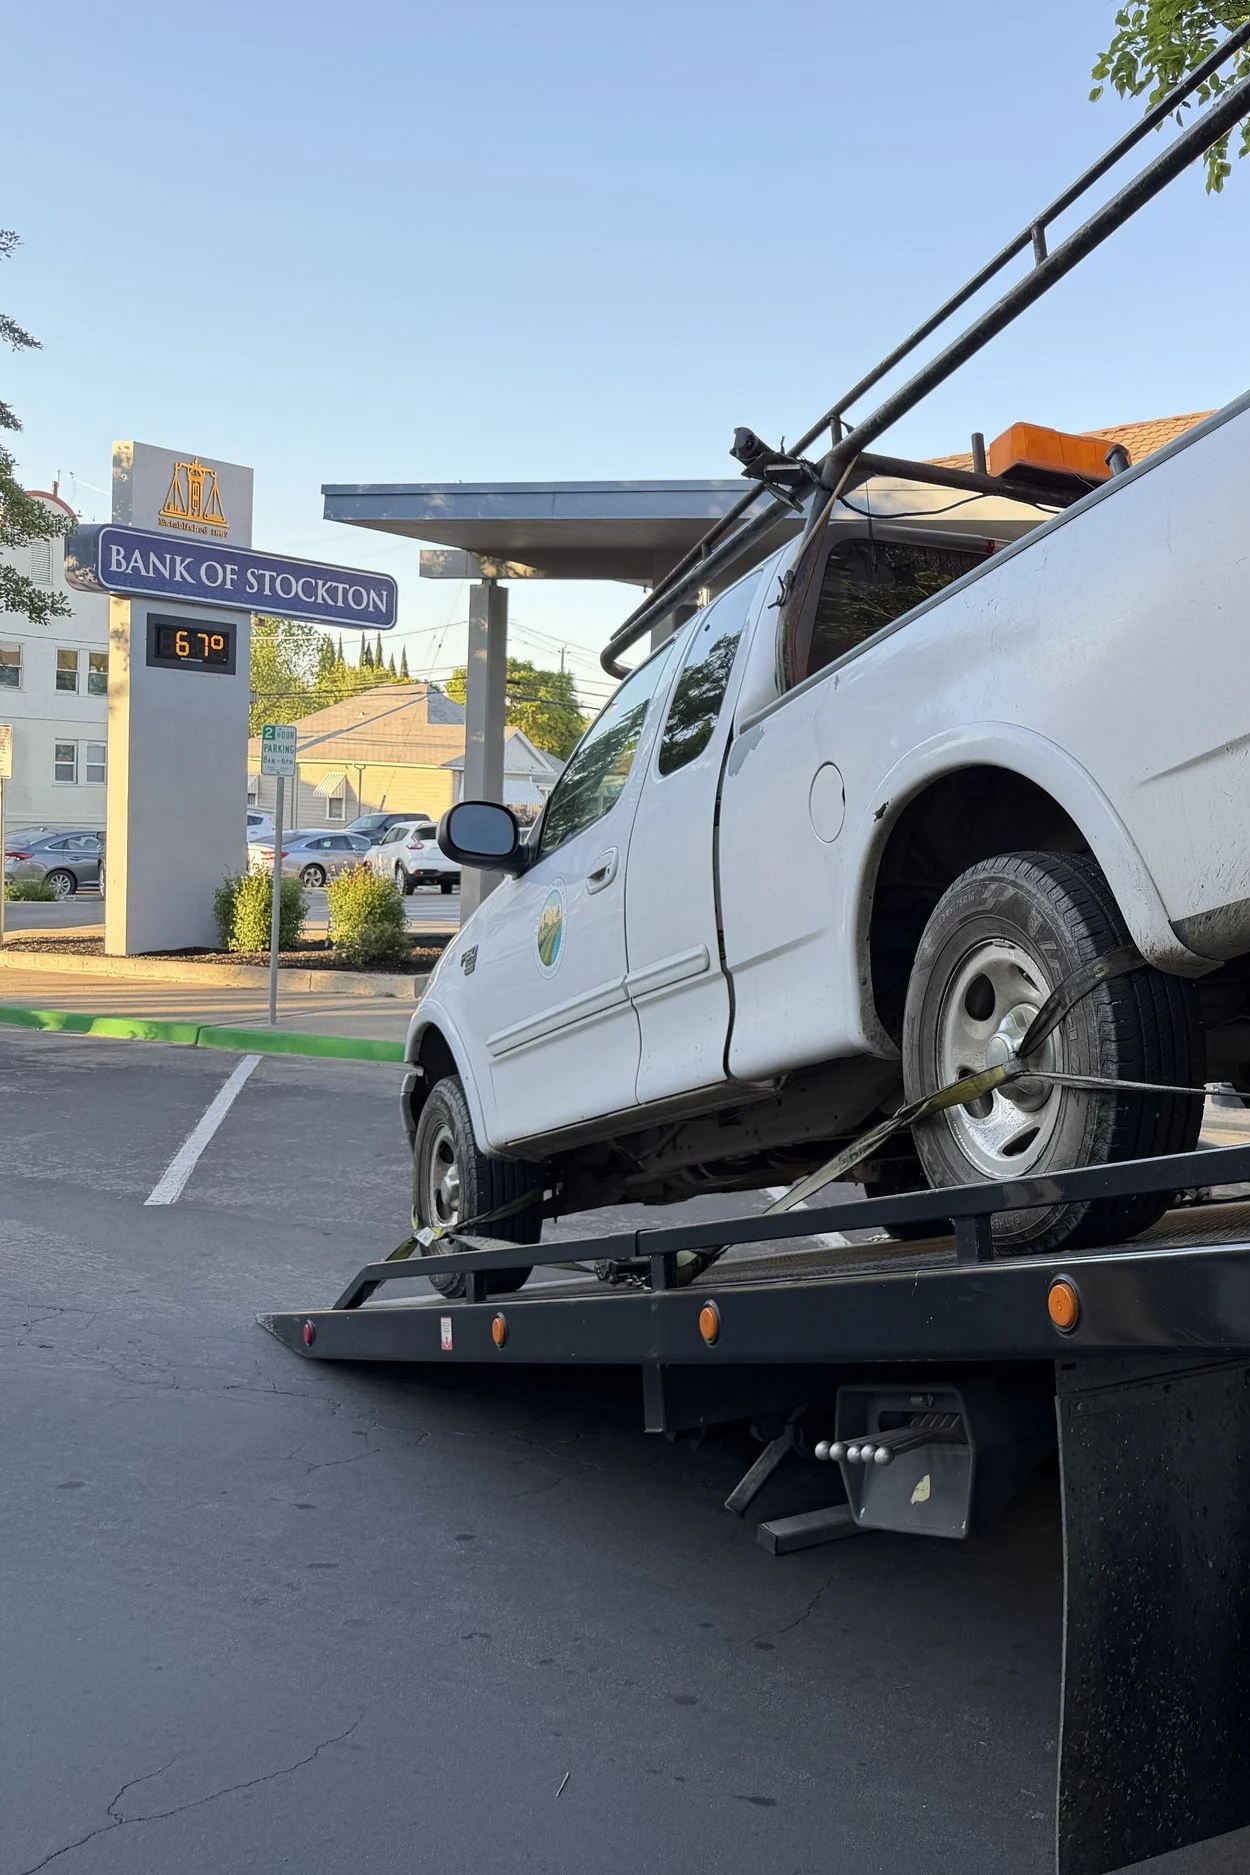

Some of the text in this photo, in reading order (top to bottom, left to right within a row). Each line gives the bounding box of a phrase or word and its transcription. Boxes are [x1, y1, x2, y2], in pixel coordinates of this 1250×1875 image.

[109, 544, 388, 614] BANK OF STOCKTON
[264, 726, 295, 740] 2 HOUR
[264, 743, 295, 754] PARKING
